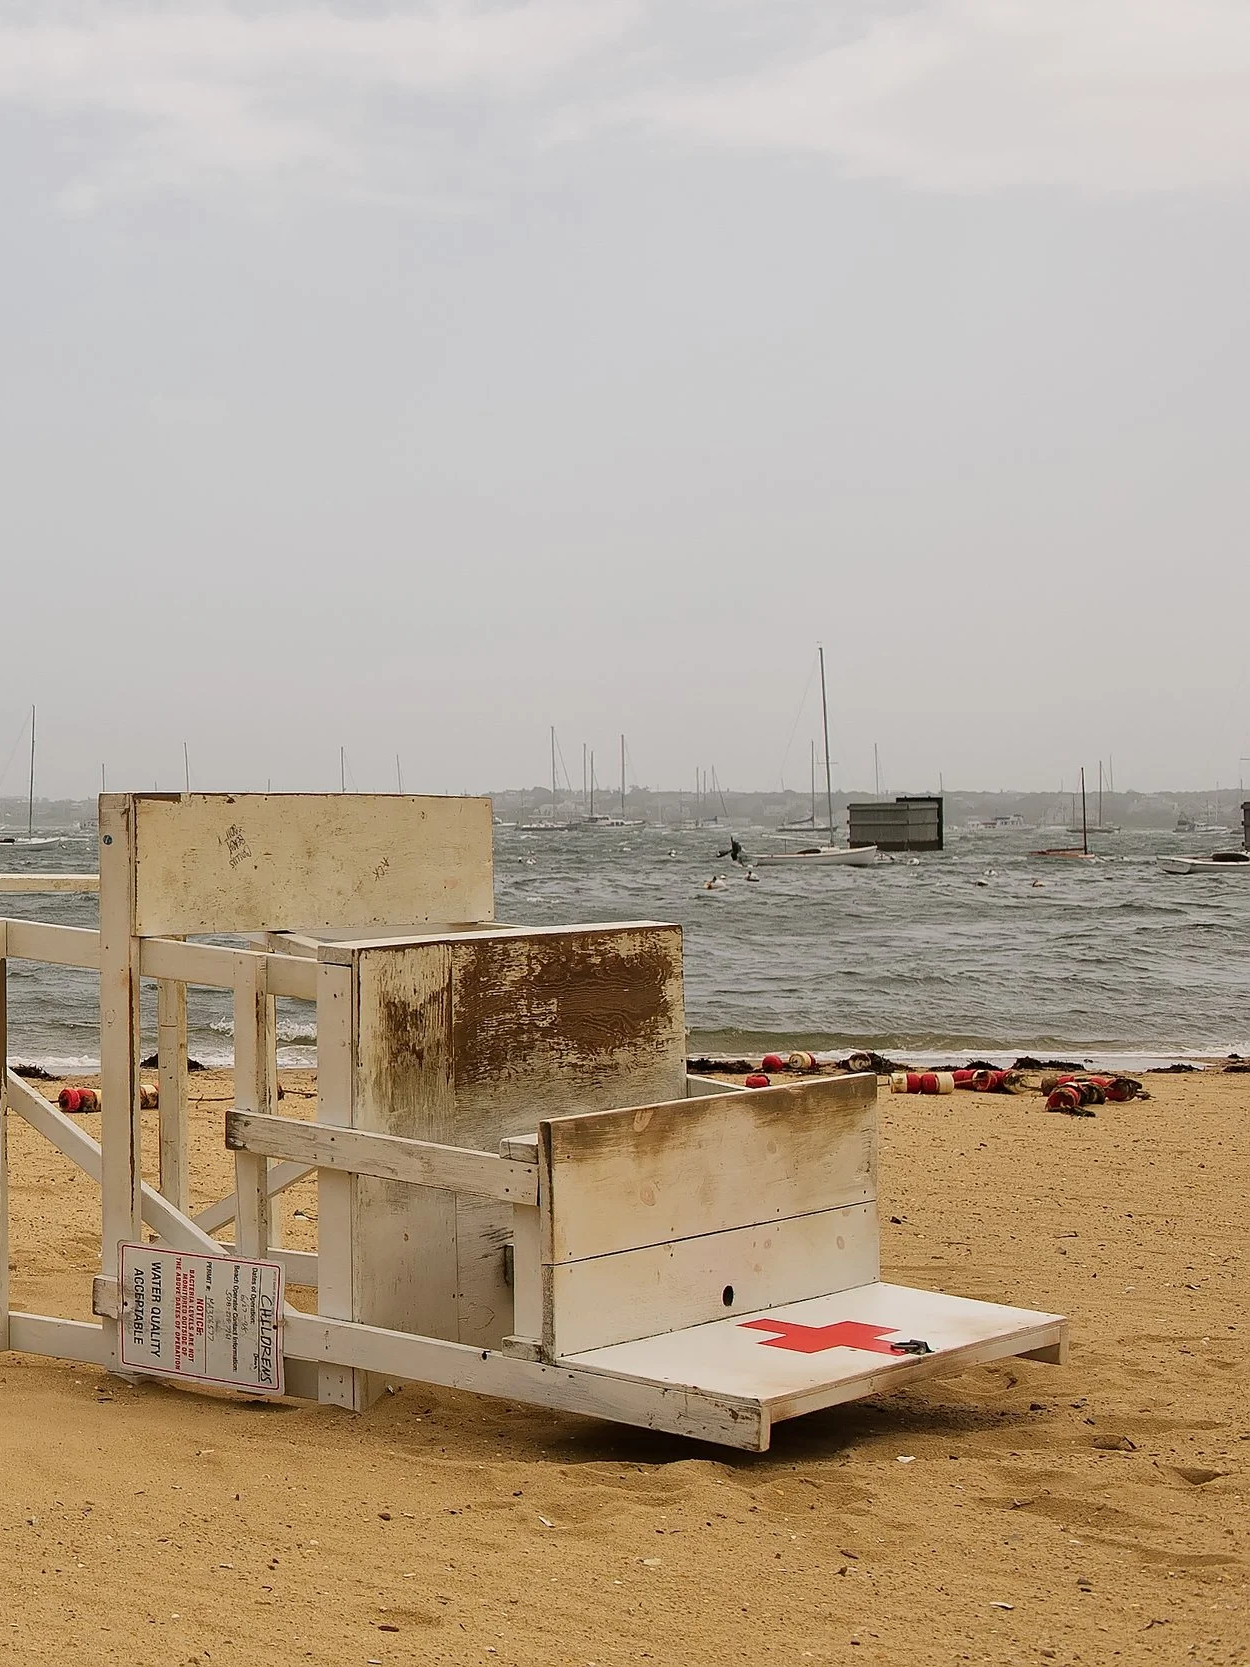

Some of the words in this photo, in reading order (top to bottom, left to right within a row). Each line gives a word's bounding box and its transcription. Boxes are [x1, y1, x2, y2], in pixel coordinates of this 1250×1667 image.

[134, 1267, 145, 1345] ACCEPTABLE
[151, 1262, 162, 1303] WATER
[150, 1306, 161, 1358] QUALITY
[196, 1298, 204, 1336] NOTICE:
[260, 1294, 273, 1384] CHILDRENS
